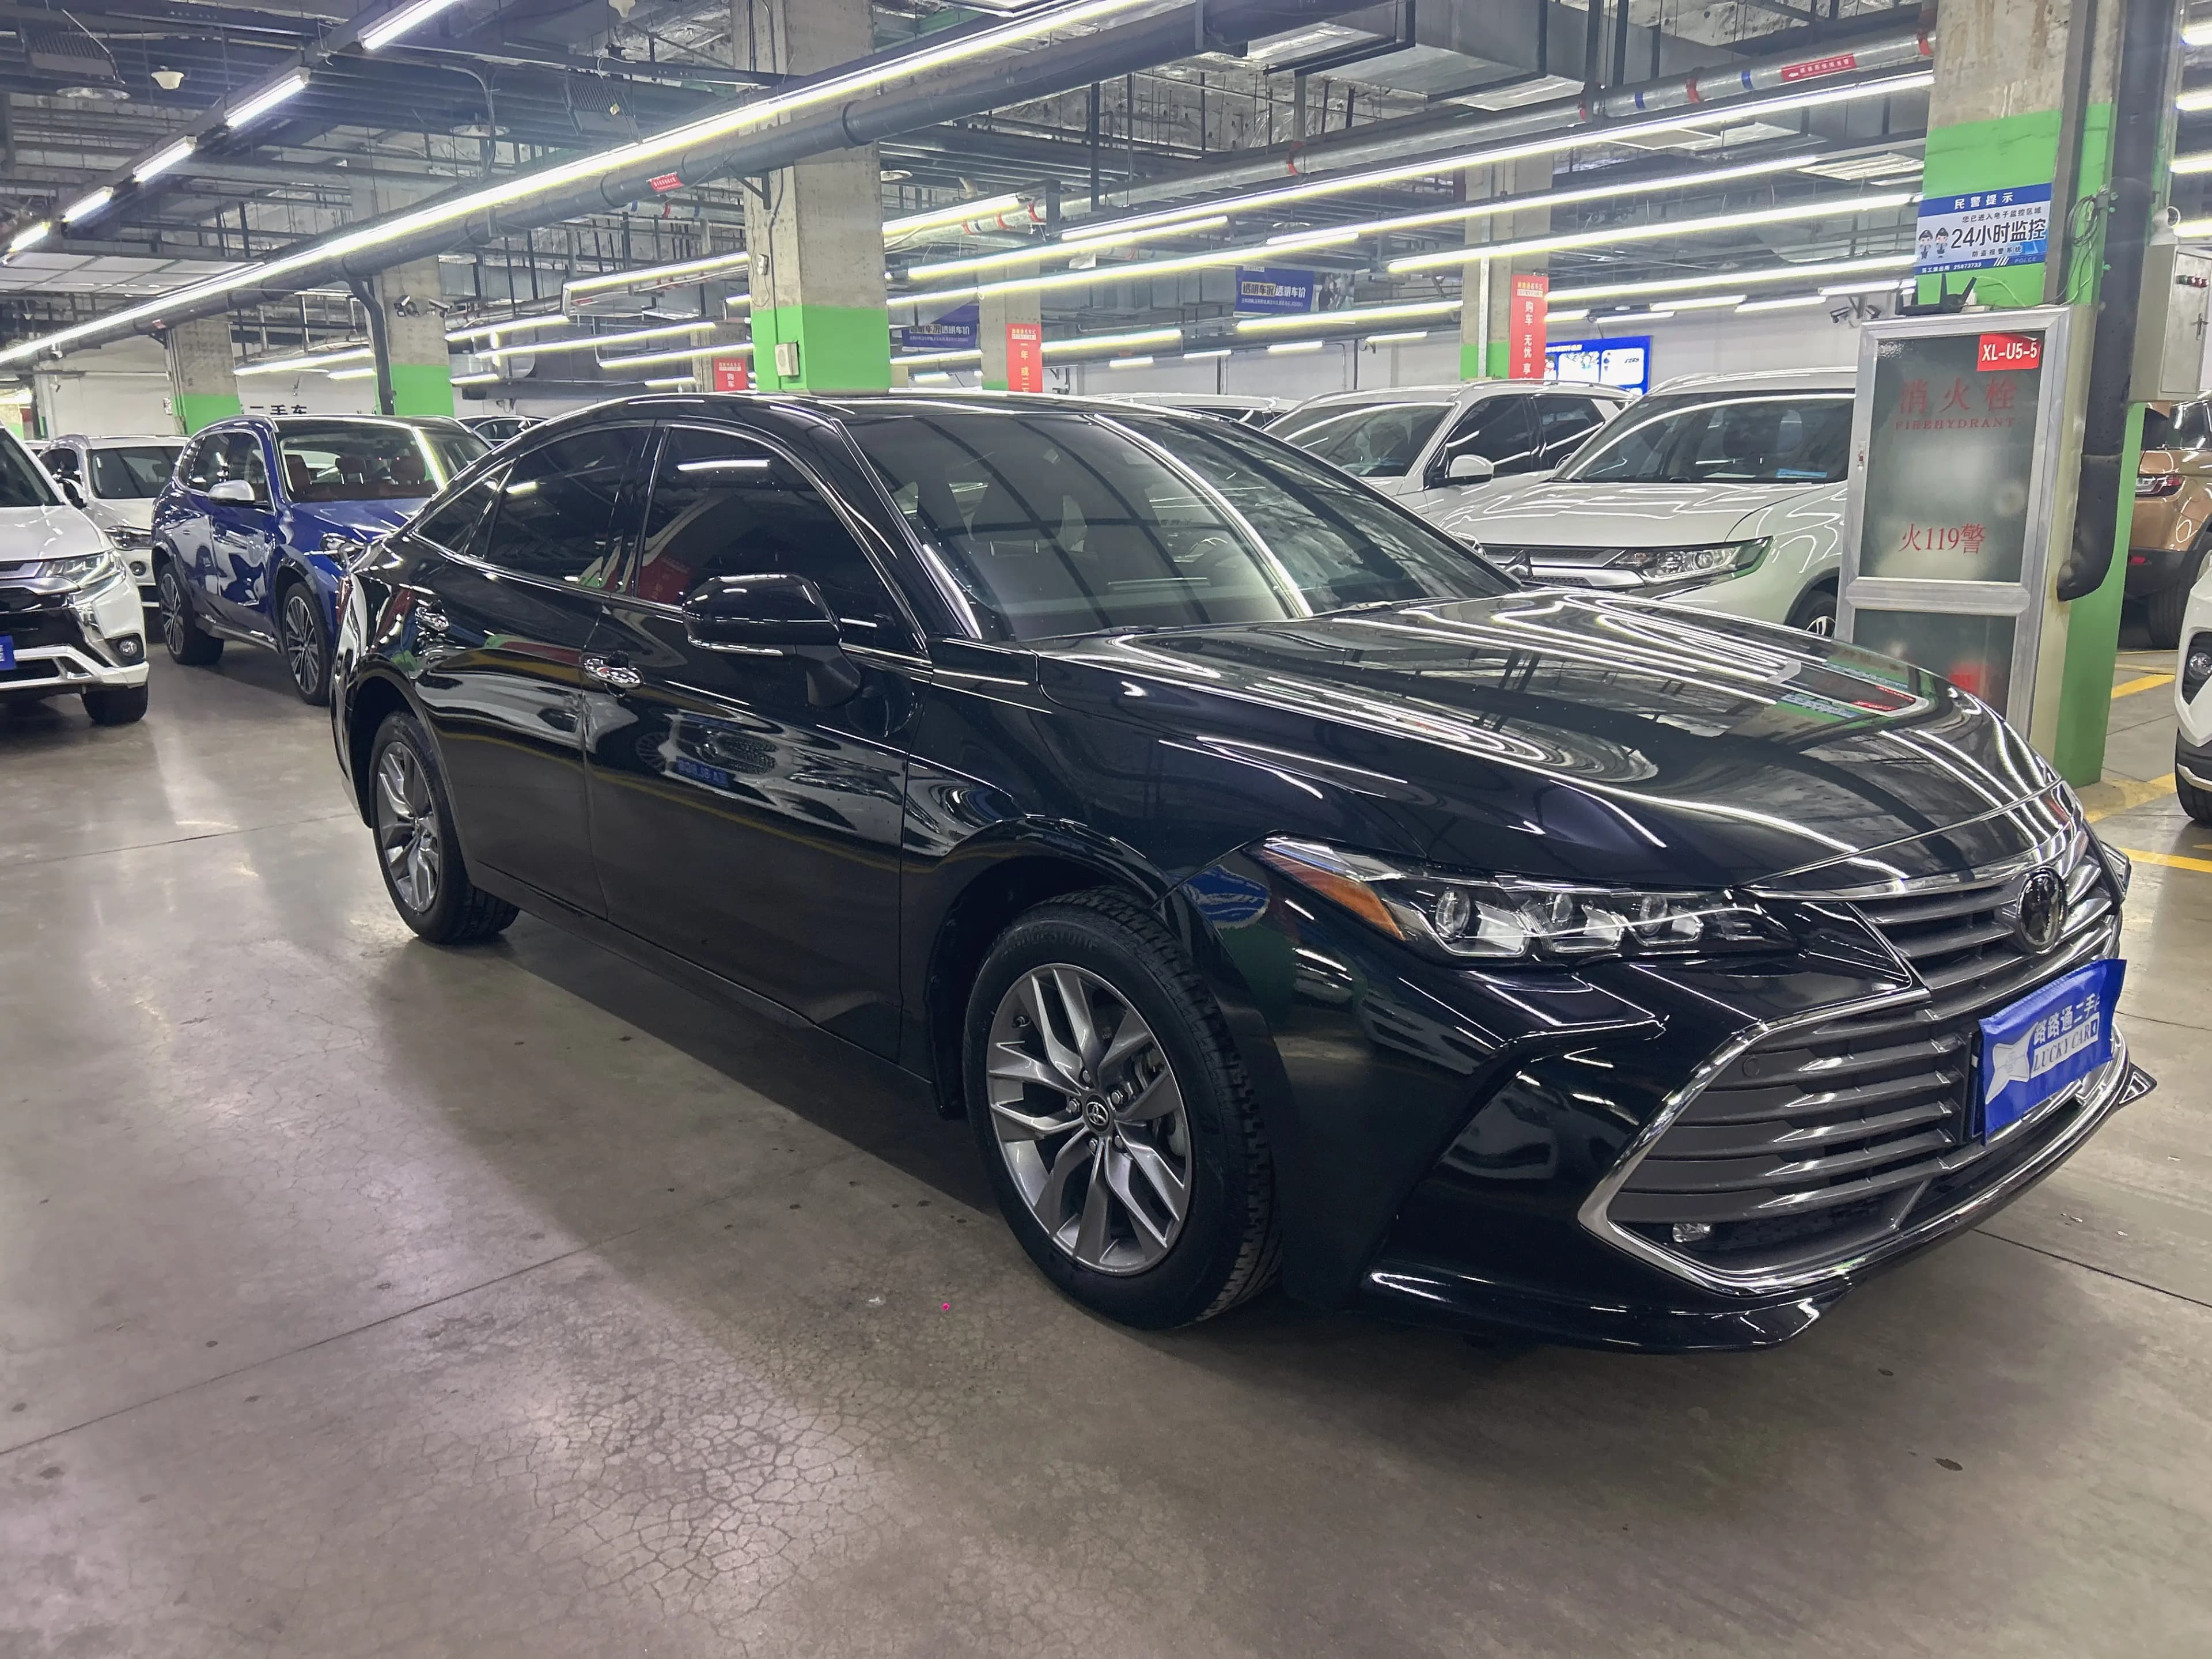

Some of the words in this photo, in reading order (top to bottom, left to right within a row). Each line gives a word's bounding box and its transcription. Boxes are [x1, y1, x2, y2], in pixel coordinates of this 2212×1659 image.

[1955, 192, 2013, 209] 民警提示
[1962, 207, 2041, 223] 您已进入电子监控区域
[1950, 218, 2046, 249] 24小时监控
[1972, 245, 2022, 257] 防盗报警系统
[1982, 342, 2037, 362] XL-U5-5
[1900, 375, 2018, 415] 消火栓
